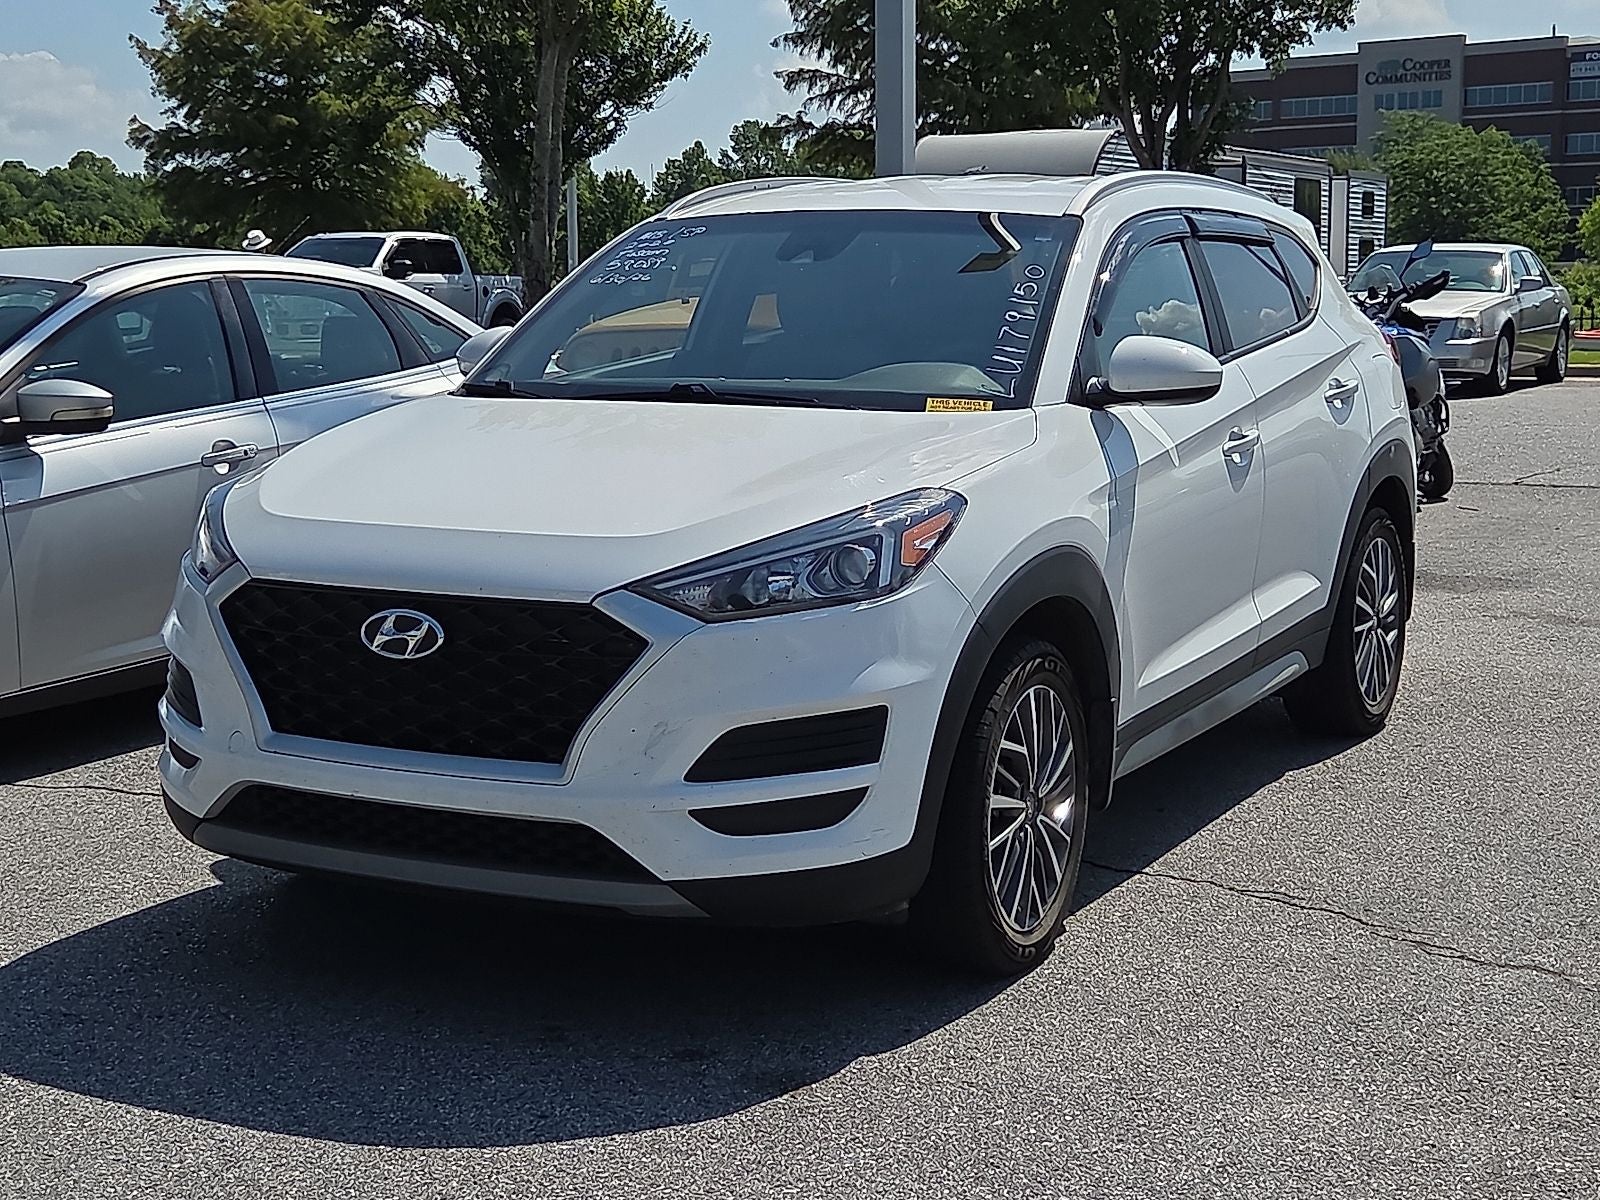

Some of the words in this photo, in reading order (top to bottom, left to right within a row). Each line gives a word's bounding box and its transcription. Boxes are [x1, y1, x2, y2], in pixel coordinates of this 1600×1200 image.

[1586, 52, 1600, 60] FO
[1402, 58, 1451, 71] COOPER
[1365, 70, 1452, 85] COMMUNITIES
[976, 263, 1046, 398] LU179150
[952, 399, 989, 408] VEHICLE
